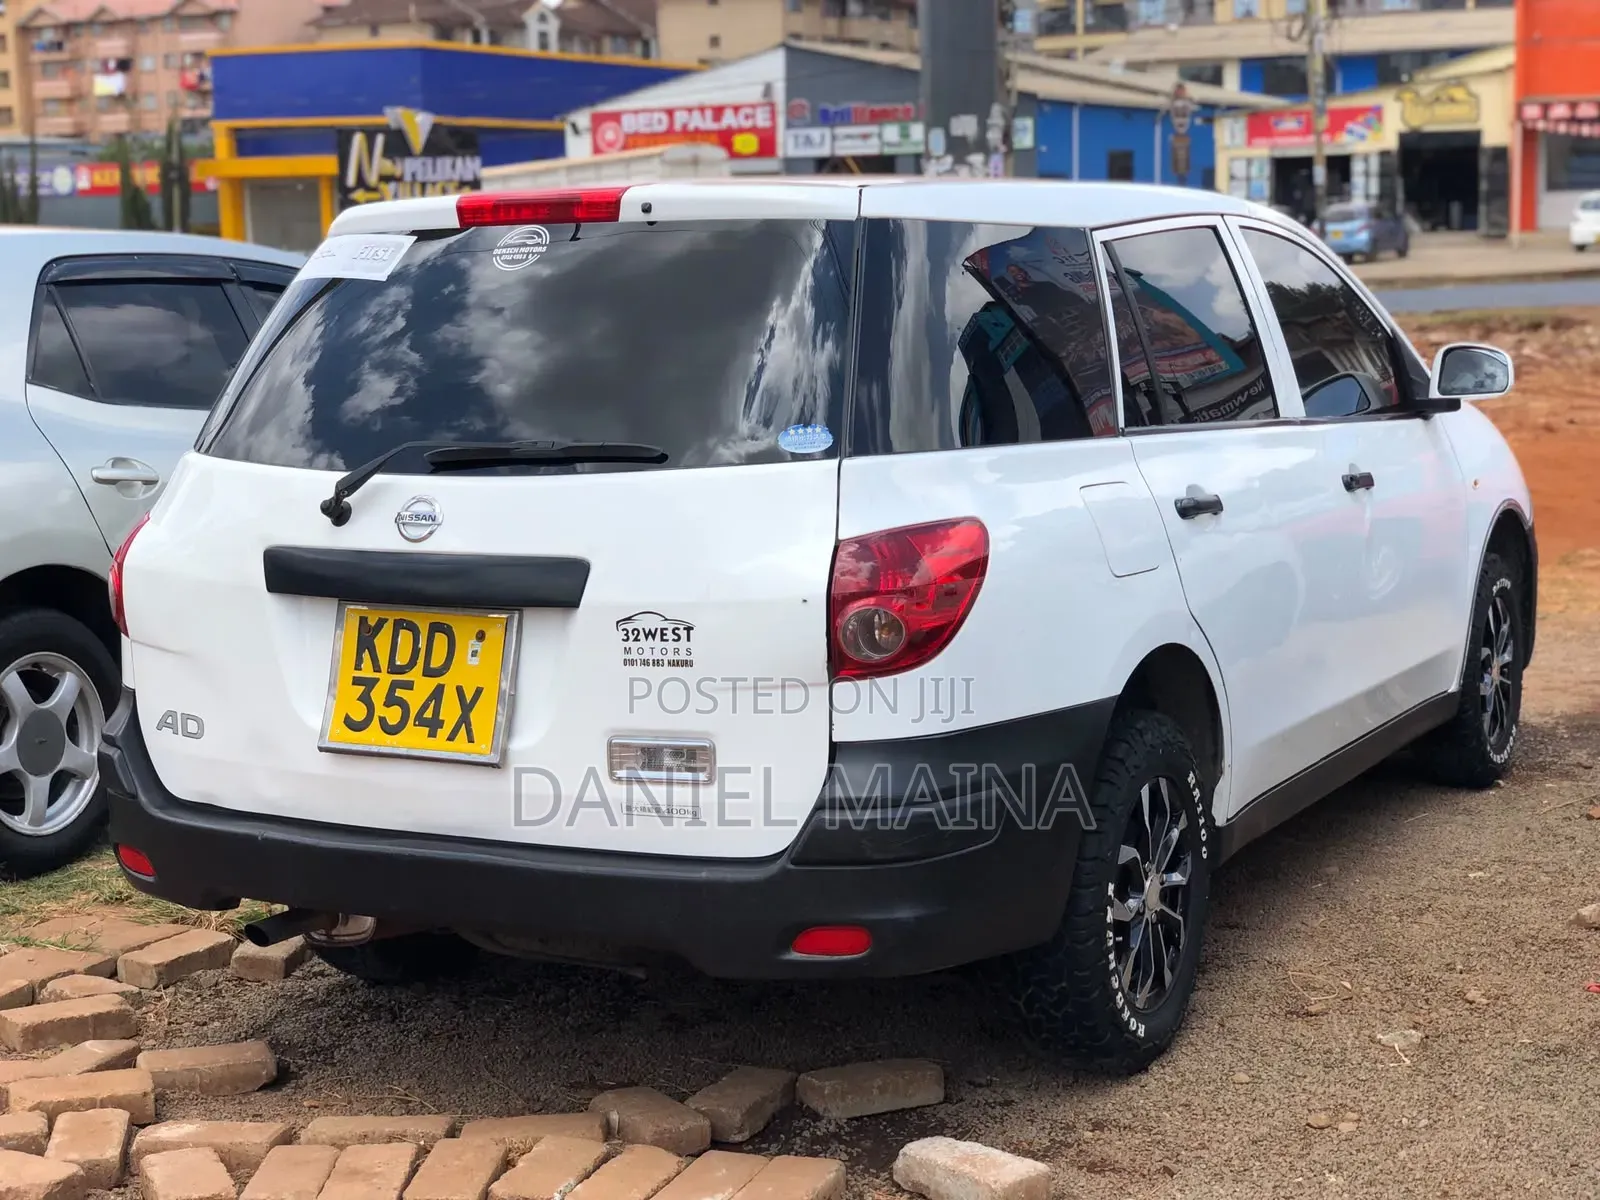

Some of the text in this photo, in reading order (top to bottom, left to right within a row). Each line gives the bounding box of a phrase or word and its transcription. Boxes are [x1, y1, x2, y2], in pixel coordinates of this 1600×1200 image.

[621, 106, 772, 133] BED PALACE
[792, 132, 826, 149] TAJ
[398, 514, 436, 522] NISSAN
[621, 626, 694, 643] 32WEST
[354, 615, 457, 678] KDD
[623, 646, 692, 656] MOTORS
[623, 658, 638, 667] 0101
[639, 658, 651, 667] 746
[667, 658, 694, 668] NAKURU
[343, 675, 485, 744] 354X
[156, 709, 204, 739] AD
